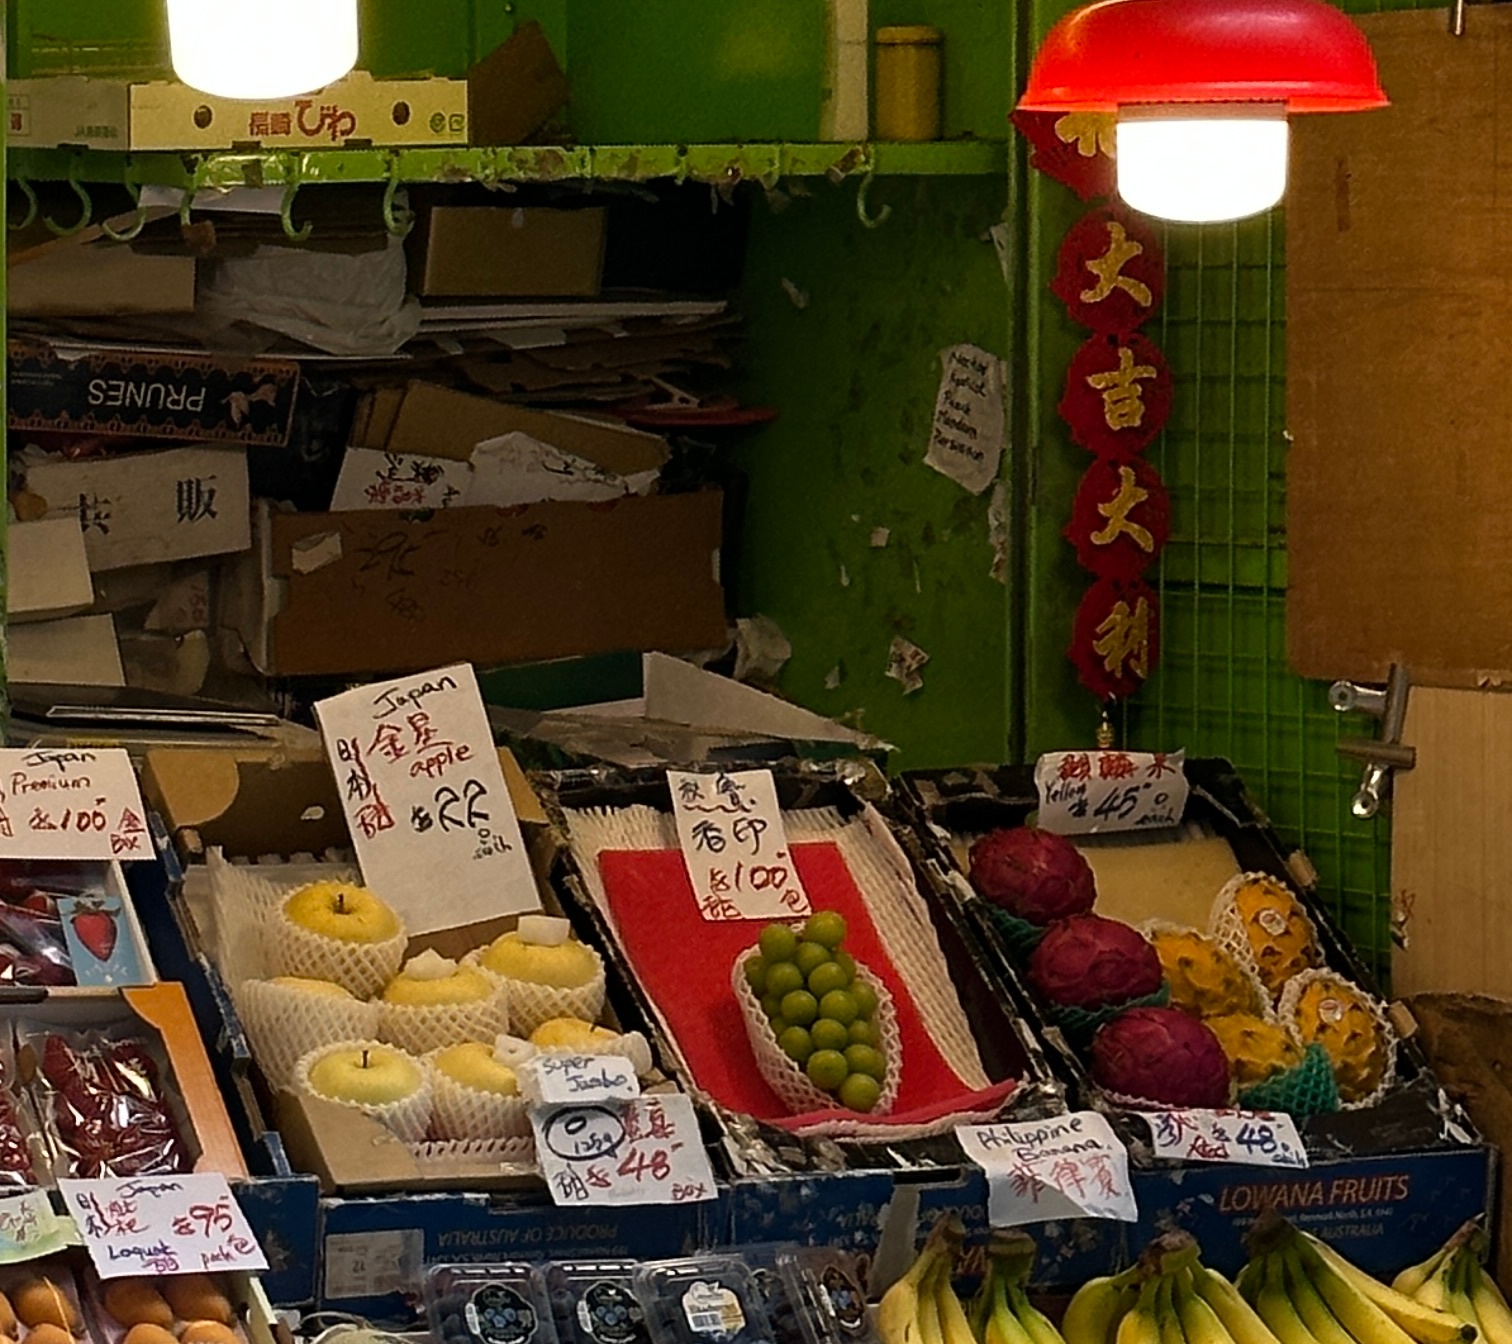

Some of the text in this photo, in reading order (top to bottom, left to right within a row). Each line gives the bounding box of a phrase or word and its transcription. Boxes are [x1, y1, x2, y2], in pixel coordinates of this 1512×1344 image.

[88, 377, 207, 413] PRUNES
[372, 675, 458, 720] Japan
[409, 743, 475, 779] apple
[1219, 1174, 1410, 1213] LOWANA FRUITS
